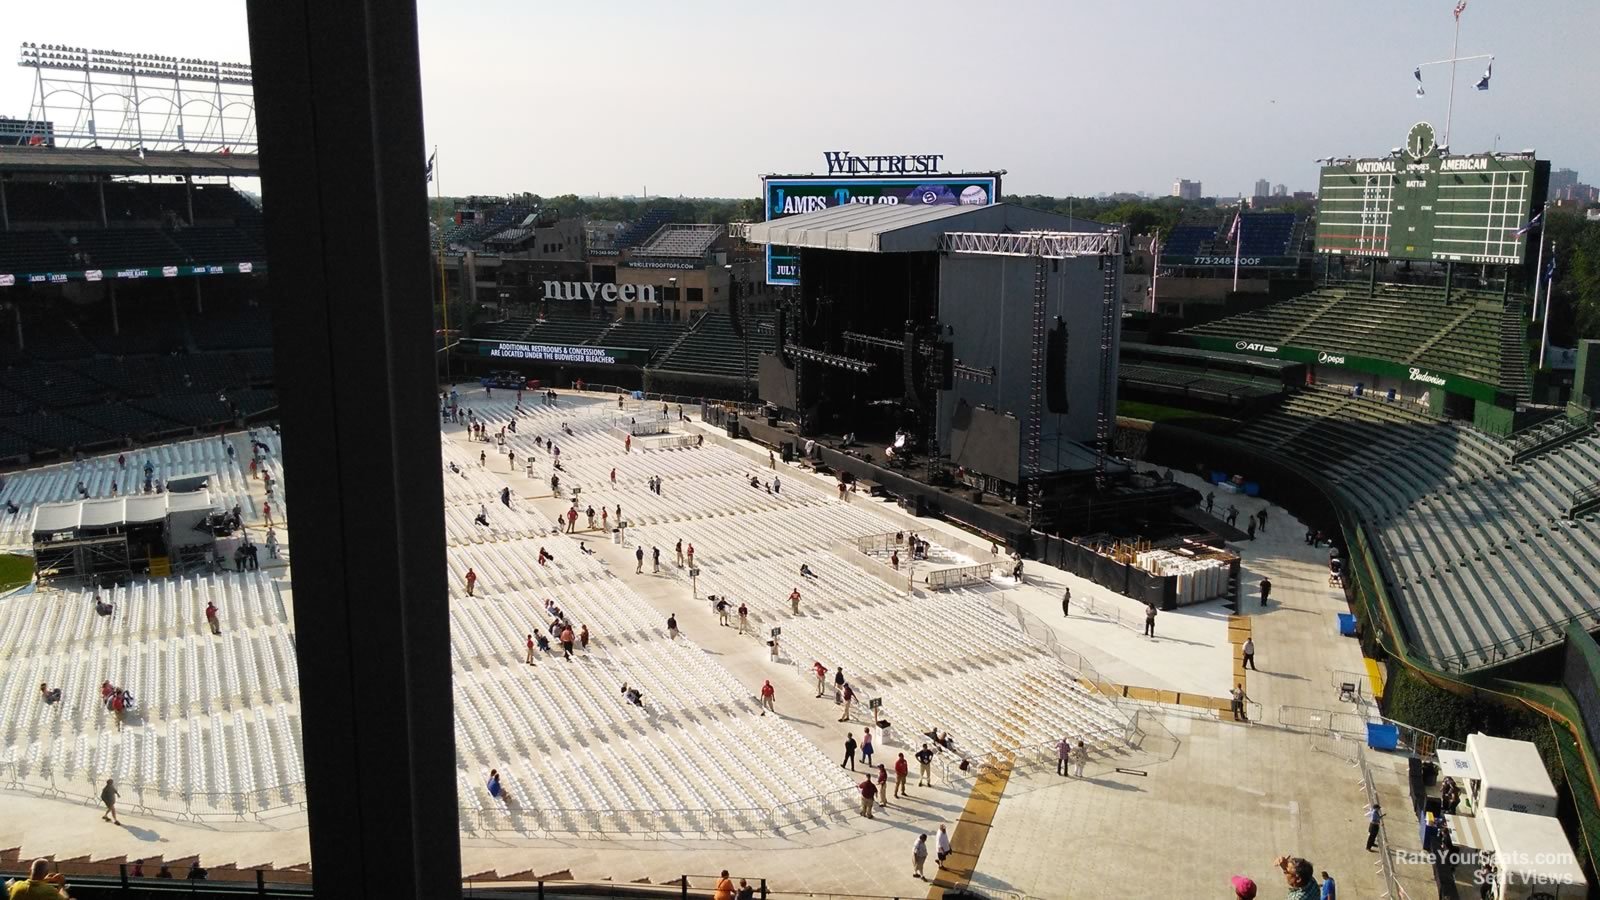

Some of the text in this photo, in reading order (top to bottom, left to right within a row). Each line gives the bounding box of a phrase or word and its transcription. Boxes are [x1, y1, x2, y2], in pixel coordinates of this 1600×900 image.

[823, 151, 943, 173] WINTRUST
[1356, 162, 1396, 172] NATIONAL
[1440, 159, 1488, 170] AMERICAN
[774, 188, 826, 214] JAMES
[777, 265, 796, 275] JULY
[543, 280, 657, 303] nuveen
[499, 343, 530, 352] ADDITIONAL
[531, 345, 562, 354] RESTROOMS
[568, 347, 606, 356] CONCESSIONS
[1246, 343, 1264, 351] ATI
[491, 349, 500, 357] ARE
[502, 350, 524, 358] LOCATED
[524, 351, 542, 359] UNDER
[554, 354, 584, 363] BUDWEISER
[586, 355, 615, 364] BLEACHERS
[1326, 355, 1345, 364] pepsi
[1409, 367, 1446, 386] Budweiser
